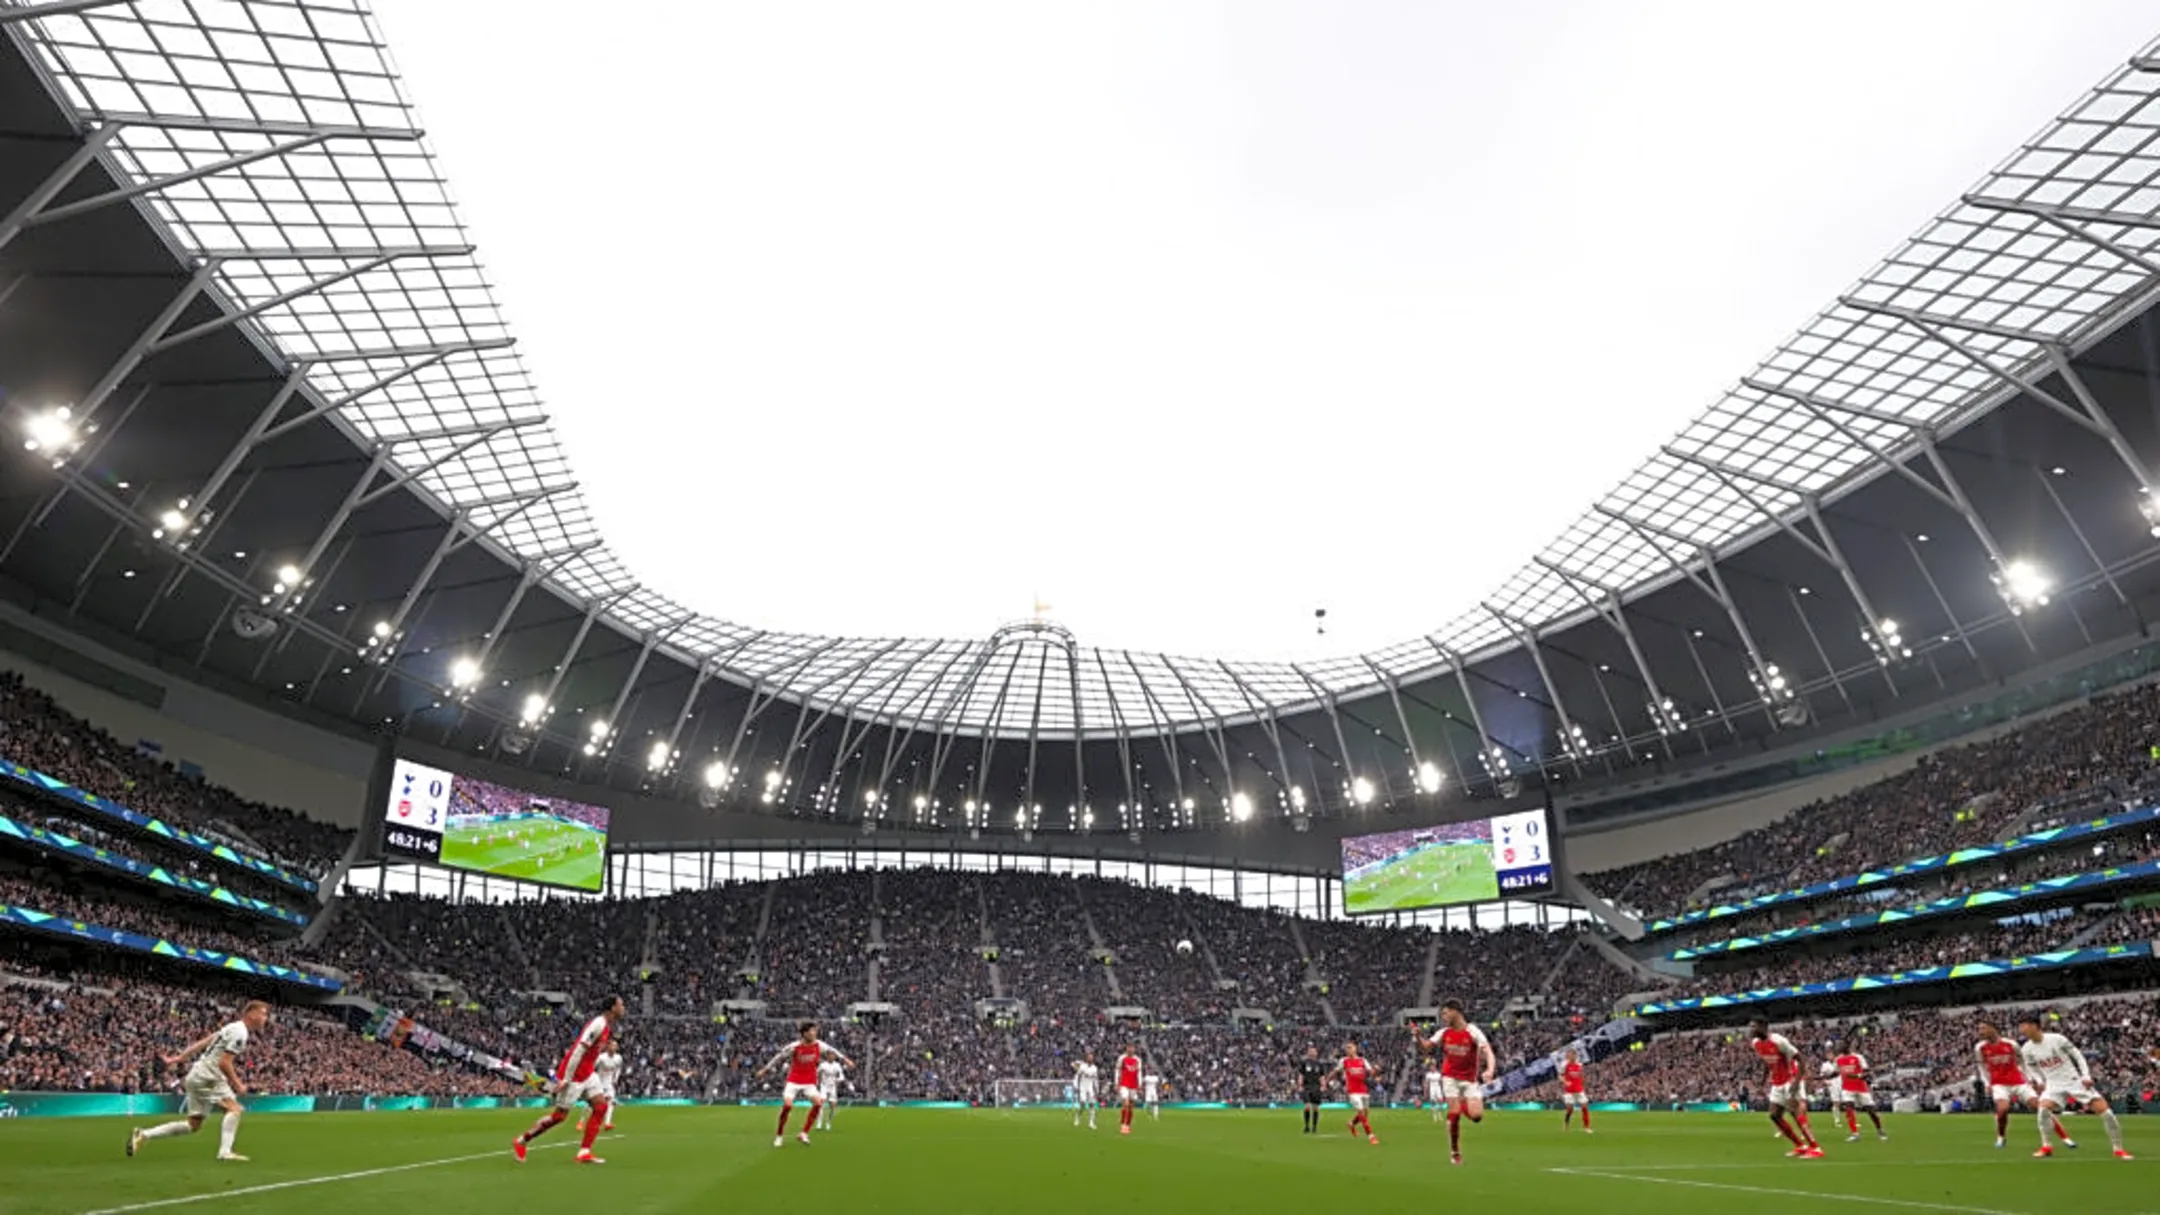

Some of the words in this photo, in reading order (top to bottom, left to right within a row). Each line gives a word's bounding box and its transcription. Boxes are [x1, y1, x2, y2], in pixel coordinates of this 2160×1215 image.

[429, 780, 442, 798] 0
[424, 807, 437, 825] 3
[1526, 820, 1538, 837] 0
[1528, 844, 1541, 861] 3
